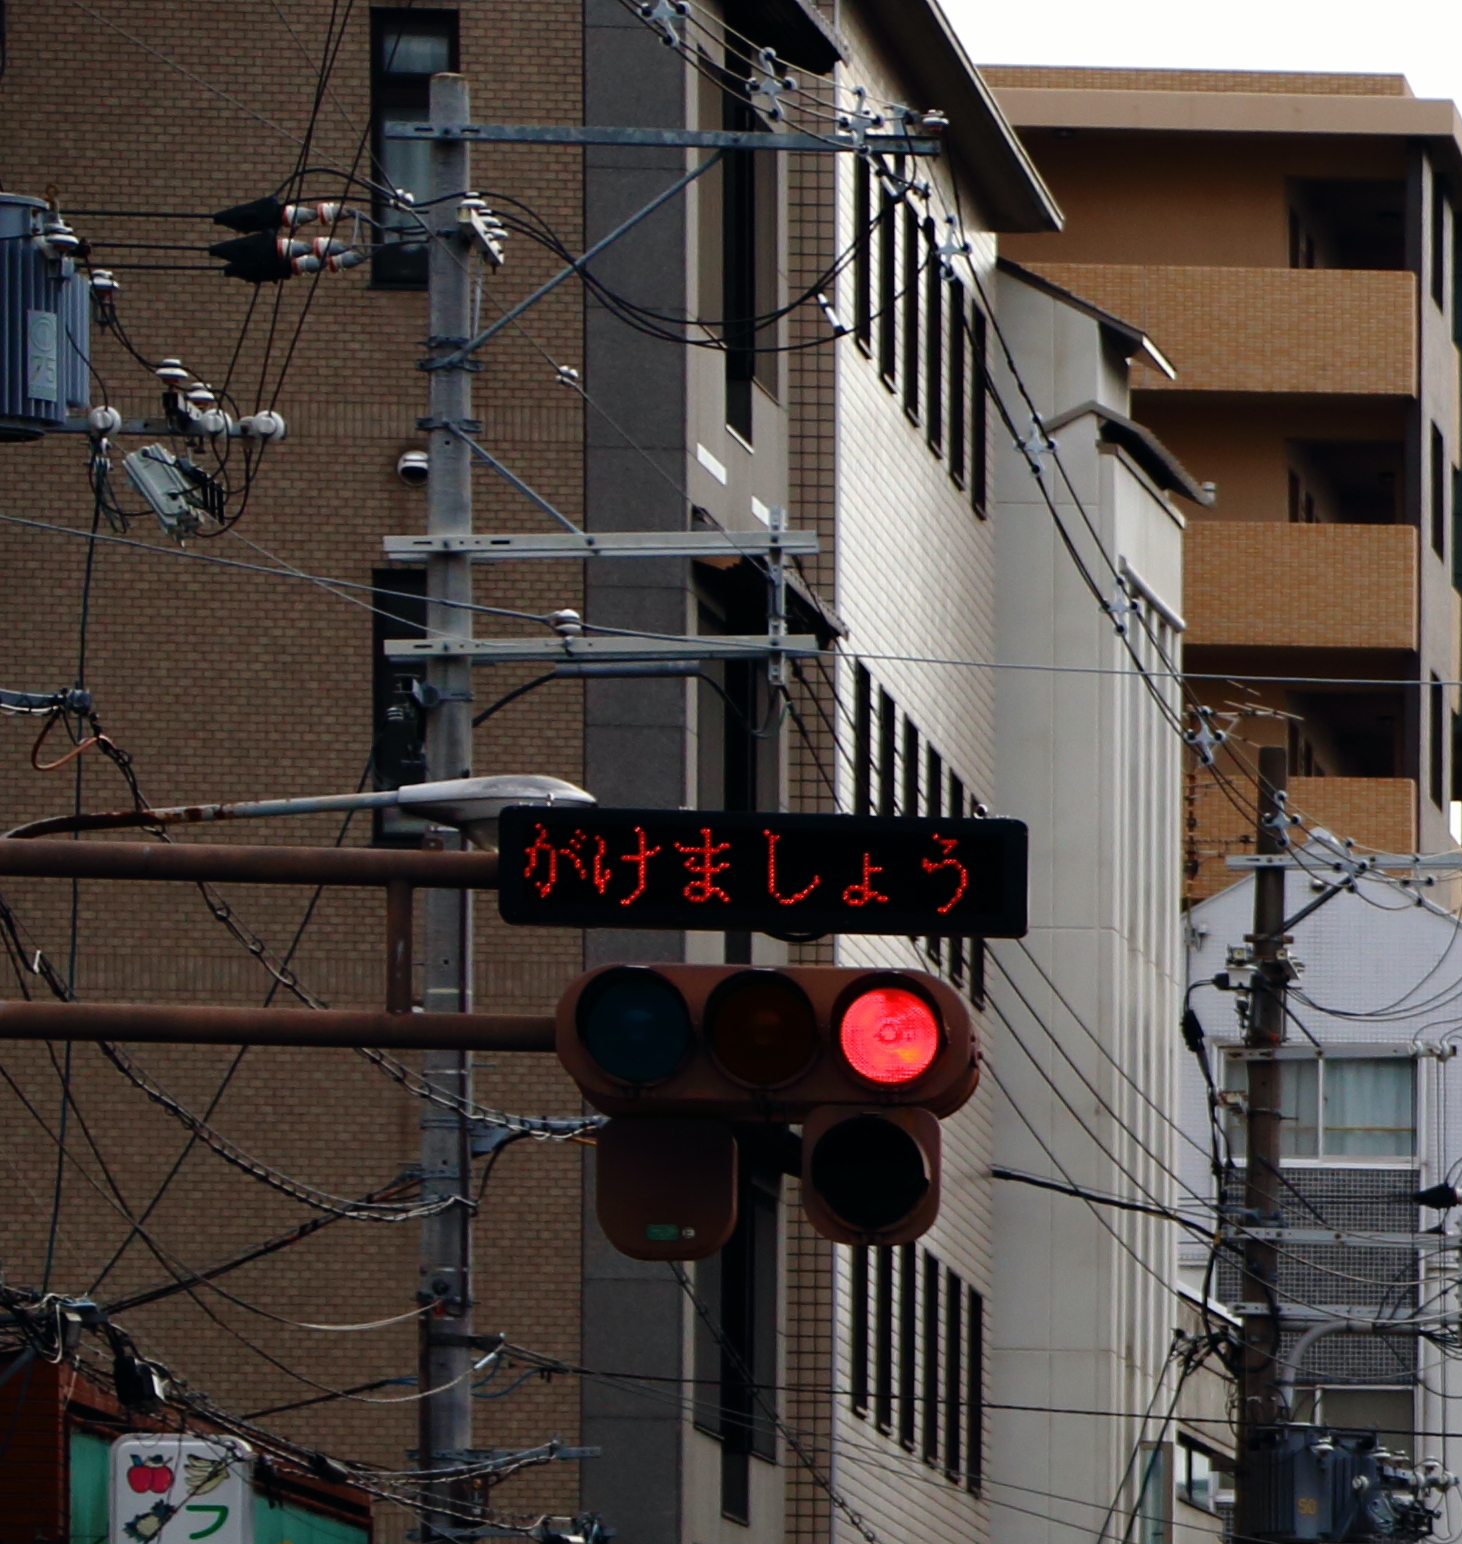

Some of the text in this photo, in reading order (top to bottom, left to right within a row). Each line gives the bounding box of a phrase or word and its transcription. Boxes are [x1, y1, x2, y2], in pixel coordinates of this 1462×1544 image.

[523, 823, 970, 915] がけましょう
